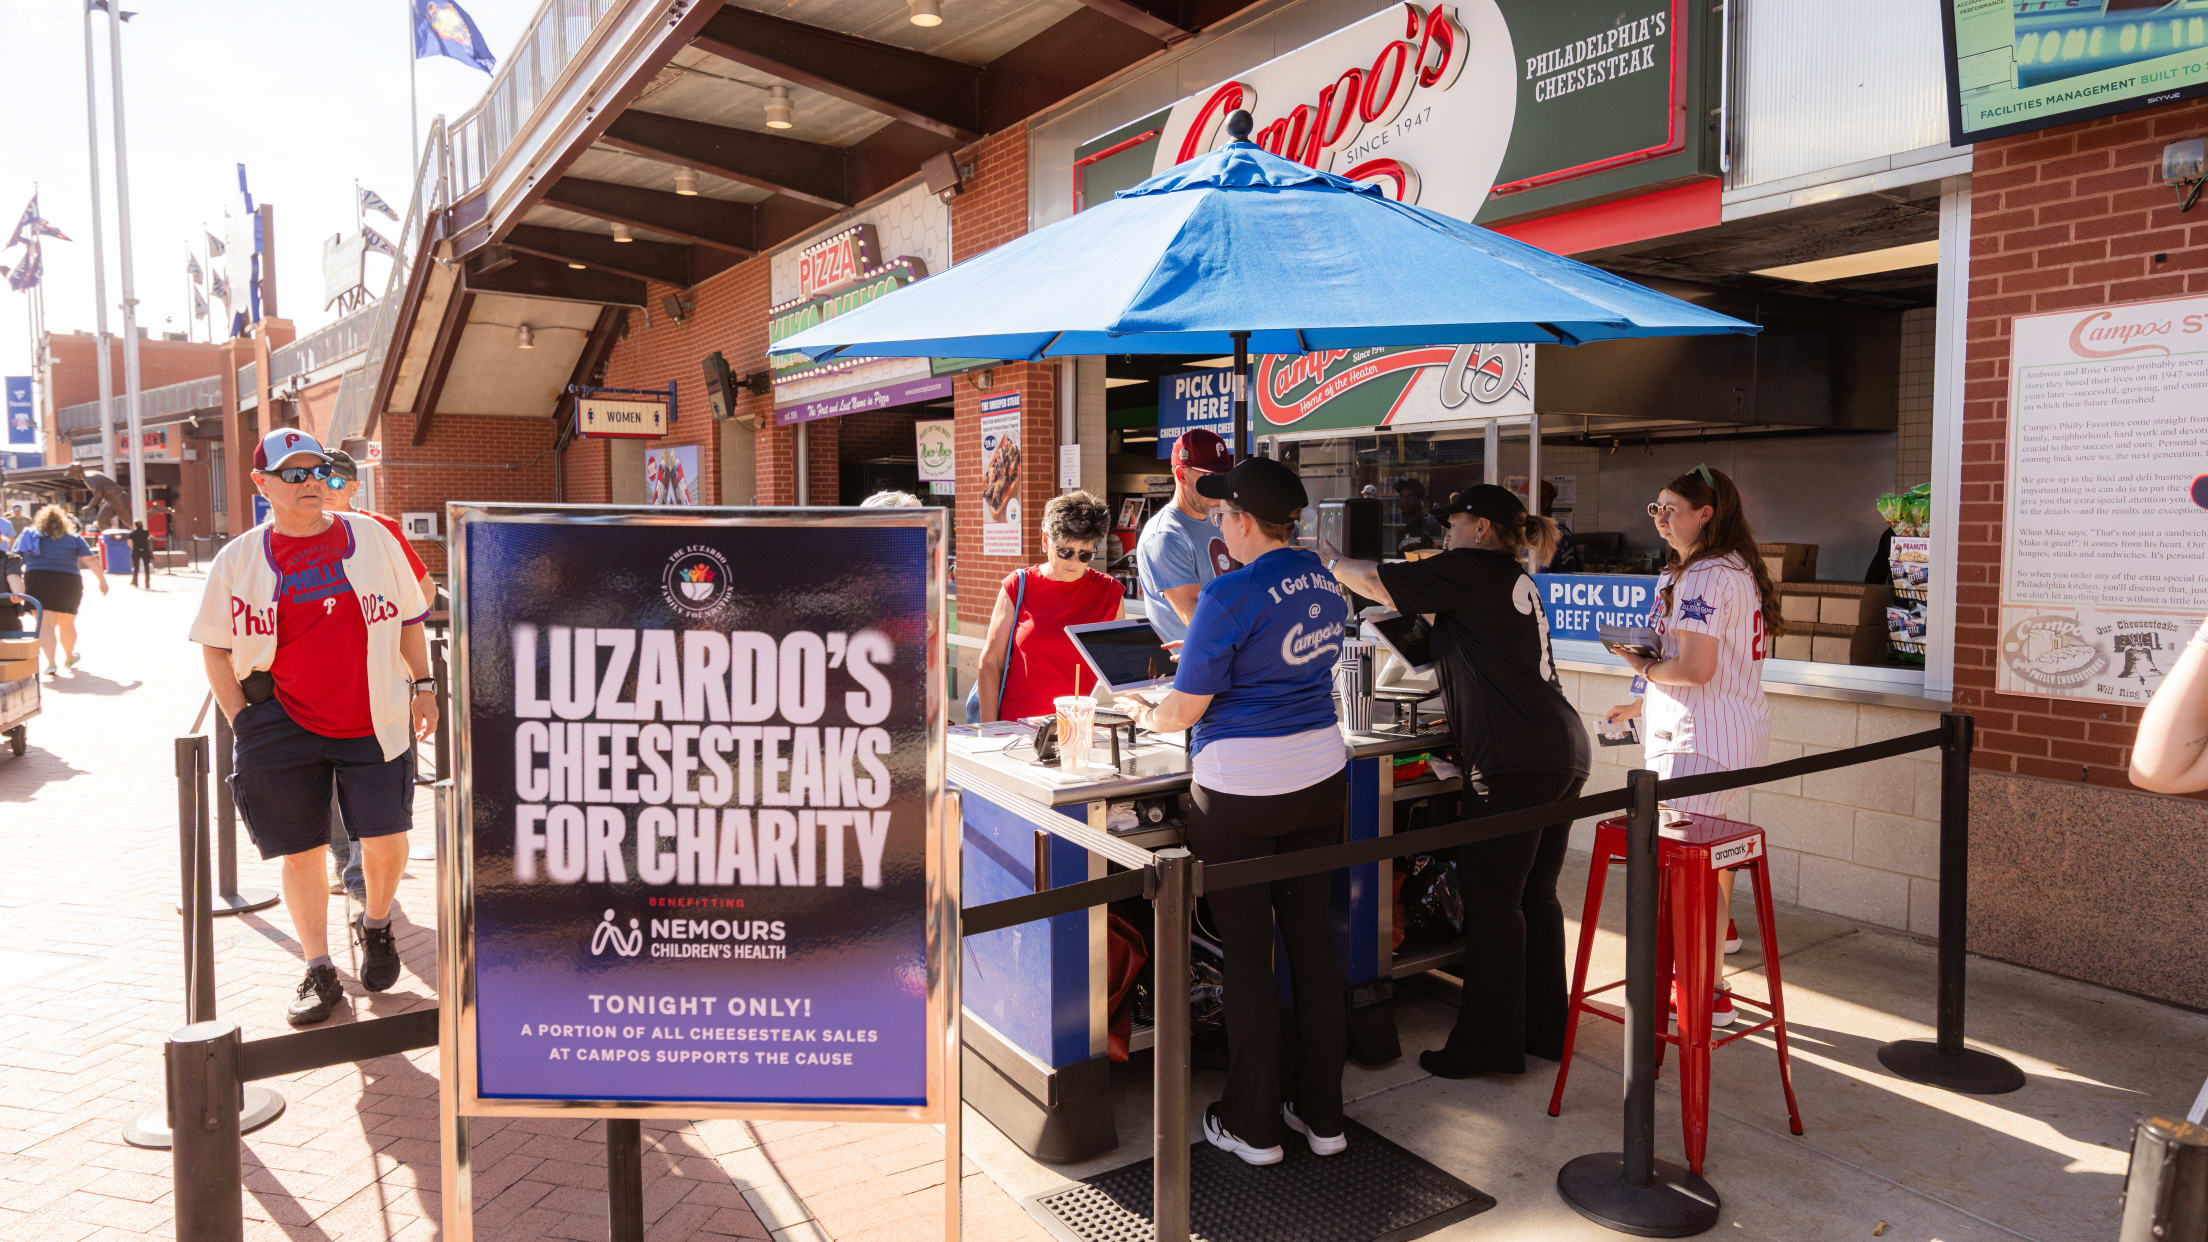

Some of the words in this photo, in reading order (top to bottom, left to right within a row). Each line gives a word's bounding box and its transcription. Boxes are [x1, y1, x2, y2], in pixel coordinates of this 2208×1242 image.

[1525, 11, 1666, 80] PHILADELPHIA'S
[1535, 44, 1655, 103] CHEESESTEAK
[1980, 98, 2042, 119] FACILITIES
[2046, 78, 2136, 105] MANAGEMENT
[2140, 68, 2178, 85] BUILT
[2183, 63, 2201, 75] TO
[1346, 131, 1389, 164] SINCE
[1395, 107, 1432, 137] 1947
[800, 238, 857, 296] PIZZA
[1352, 348, 1371, 363] Since
[1440, 343, 1522, 409] 75
[2081, 367, 2102, 375] Rose
[2104, 365, 2134, 374] Campo
[2137, 360, 2176, 372] probably
[1175, 374, 1213, 400] PICK
[1219, 371, 1235, 394] U
[1299, 392, 1323, 414] Home
[1324, 383, 1334, 397] of
[1335, 377, 1348, 390] the
[1350, 365, 1379, 384] Heater
[829, 401, 838, 413] and
[839, 399, 851, 412] Last
[873, 391, 890, 407] Pizza
[1186, 396, 1229, 421] HERE
[606, 411, 641, 424] WOMEN
[284, 432, 300, 449] P
[1160, 427, 1181, 438] CHICKEN
[1215, 442, 1225, 457] P
[2019, 528, 2042, 536] When
[2045, 528, 2066, 536] Mike
[2122, 529, 2136, 537] not
[2138, 529, 2154, 538] just
[1903, 542, 1928, 551] PEANUTS
[2018, 539, 2040, 547] Make
[2121, 540, 2141, 548] from
[2144, 540, 2158, 548] his
[2187, 540, 2206, 548] Our
[668, 548, 686, 562] THE
[686, 544, 727, 564] LUZARDO
[2151, 551, 2164, 559] It's
[2166, 552, 2205, 560] personal
[2016, 569, 2027, 577] So
[2030, 570, 2051, 578] when
[2053, 571, 2068, 579] you
[2070, 571, 2092, 579] order
[2111, 572, 2122, 580] of
[2123, 572, 2137, 580] the
[2139, 573, 2161, 581] extra
[2164, 574, 2195, 583] special
[1267, 586, 1282, 604] I
[1281, 574, 1310, 596] Got
[1550, 583, 1604, 606] PICK
[1612, 585, 1646, 608] UP
[2016, 580, 2066, 590] Philadelphia
[2068, 581, 2100, 590] kitchen,
[2103, 583, 2126, 592] you'll
[2129, 583, 2166, 592] discover
[2190, 586, 2207, 595] just
[323, 597, 337, 615] P
[660, 584, 684, 614] FAMILY
[2029, 591, 2049, 599] don't
[2051, 591, 2061, 600] let
[2063, 592, 2099, 602] anything
[2102, 593, 2124, 602] leave
[2127, 595, 2159, 603] without
[2170, 596, 2191, 605] little
[1308, 603, 1321, 619] @
[1555, 609, 1591, 631] BEEF
[2096, 625, 2112, 635] Our
[2116, 620, 2179, 632] Cheesesteaks
[1281, 621, 1344, 666] Campo's
[514, 624, 893, 725] LUZARDO'S
[2096, 683, 2114, 695] Will
[2119, 688, 2140, 700] Ring
[515, 721, 892, 808] CHEESESTEAKS
[515, 803, 628, 884] FOR
[637, 806, 892, 888] CHARITY
[1715, 843, 1746, 861] aramark
[648, 896, 745, 909] BENEFITTING
[650, 918, 786, 941] NEMOURS
[650, 942, 731, 959] CHILDREN'S
[734, 943, 786, 960] HEALTH
[588, 994, 717, 1016] TONIGHT
[728, 997, 812, 1018] ONLY!
[521, 1023, 533, 1036] A
[538, 1024, 617, 1039] PORTION
[622, 1025, 646, 1039] OF
[651, 1026, 684, 1040] ALL
[689, 1027, 817, 1043] CHEESESTEAK
[822, 1029, 878, 1043] SALES
[549, 1047, 570, 1061] AT
[576, 1048, 651, 1063] CAMPOS
[655, 1049, 749, 1065] SUPPORTS
[754, 1051, 790, 1065] THE
[795, 1052, 853, 1066] CAUSE
